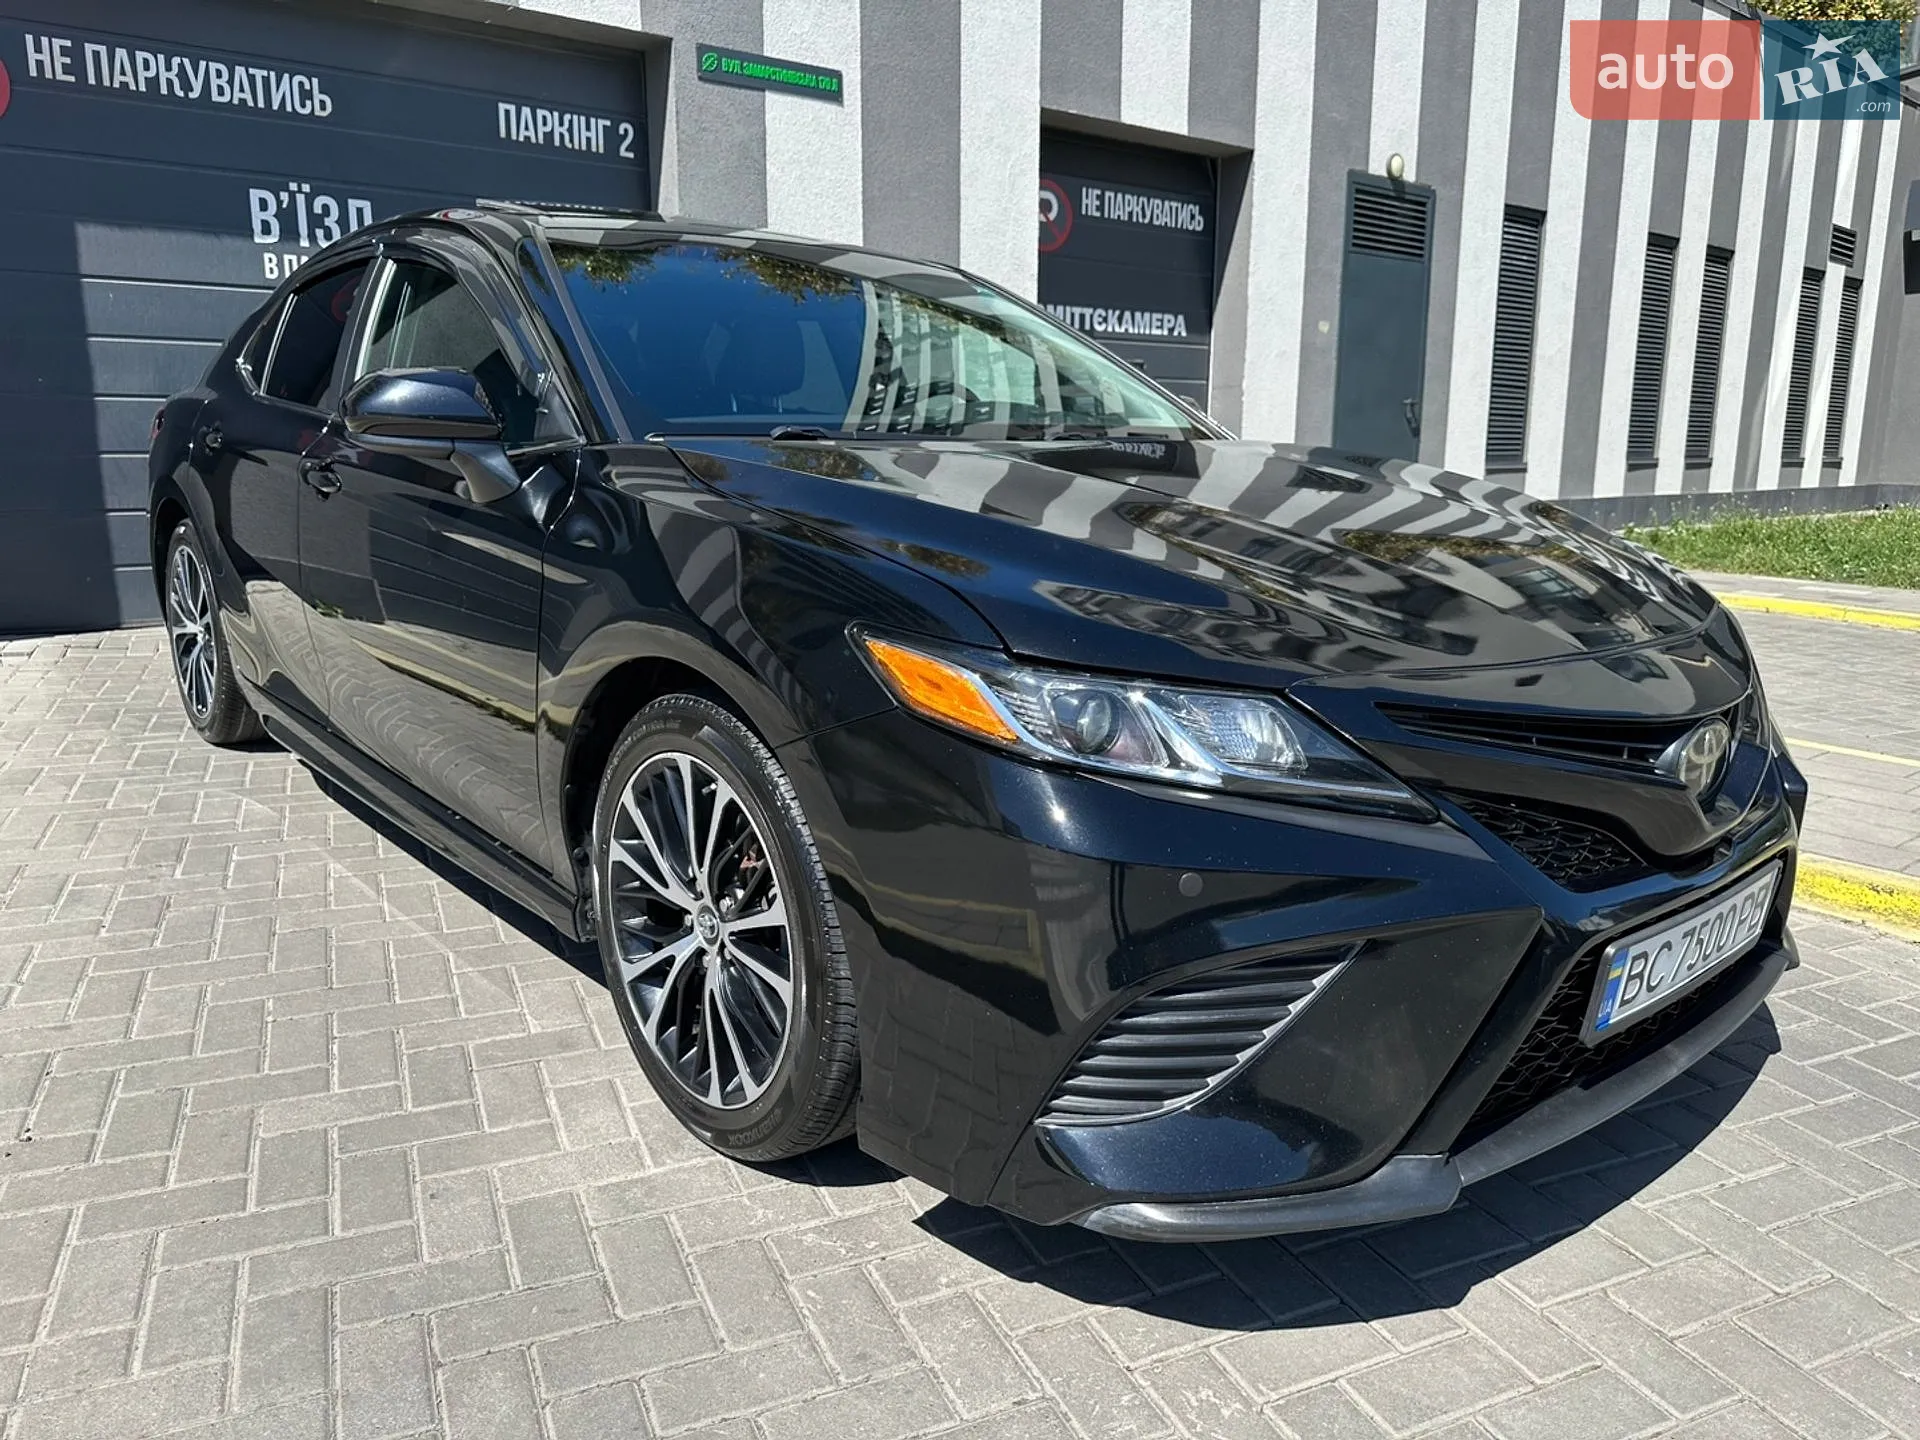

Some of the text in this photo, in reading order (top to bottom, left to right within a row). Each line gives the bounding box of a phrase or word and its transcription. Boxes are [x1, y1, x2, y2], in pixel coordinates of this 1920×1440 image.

[25, 34, 332, 117] НЕ ПАРКУВАТИСЬ
[498, 103, 635, 159] ПАРКІНГ 2
[1081, 187, 1102, 217] НЕ
[1104, 191, 1204, 231] ПАРКУВАТИСЬ
[1039, 303, 1187, 337] МІТТЄКАМЕРА
